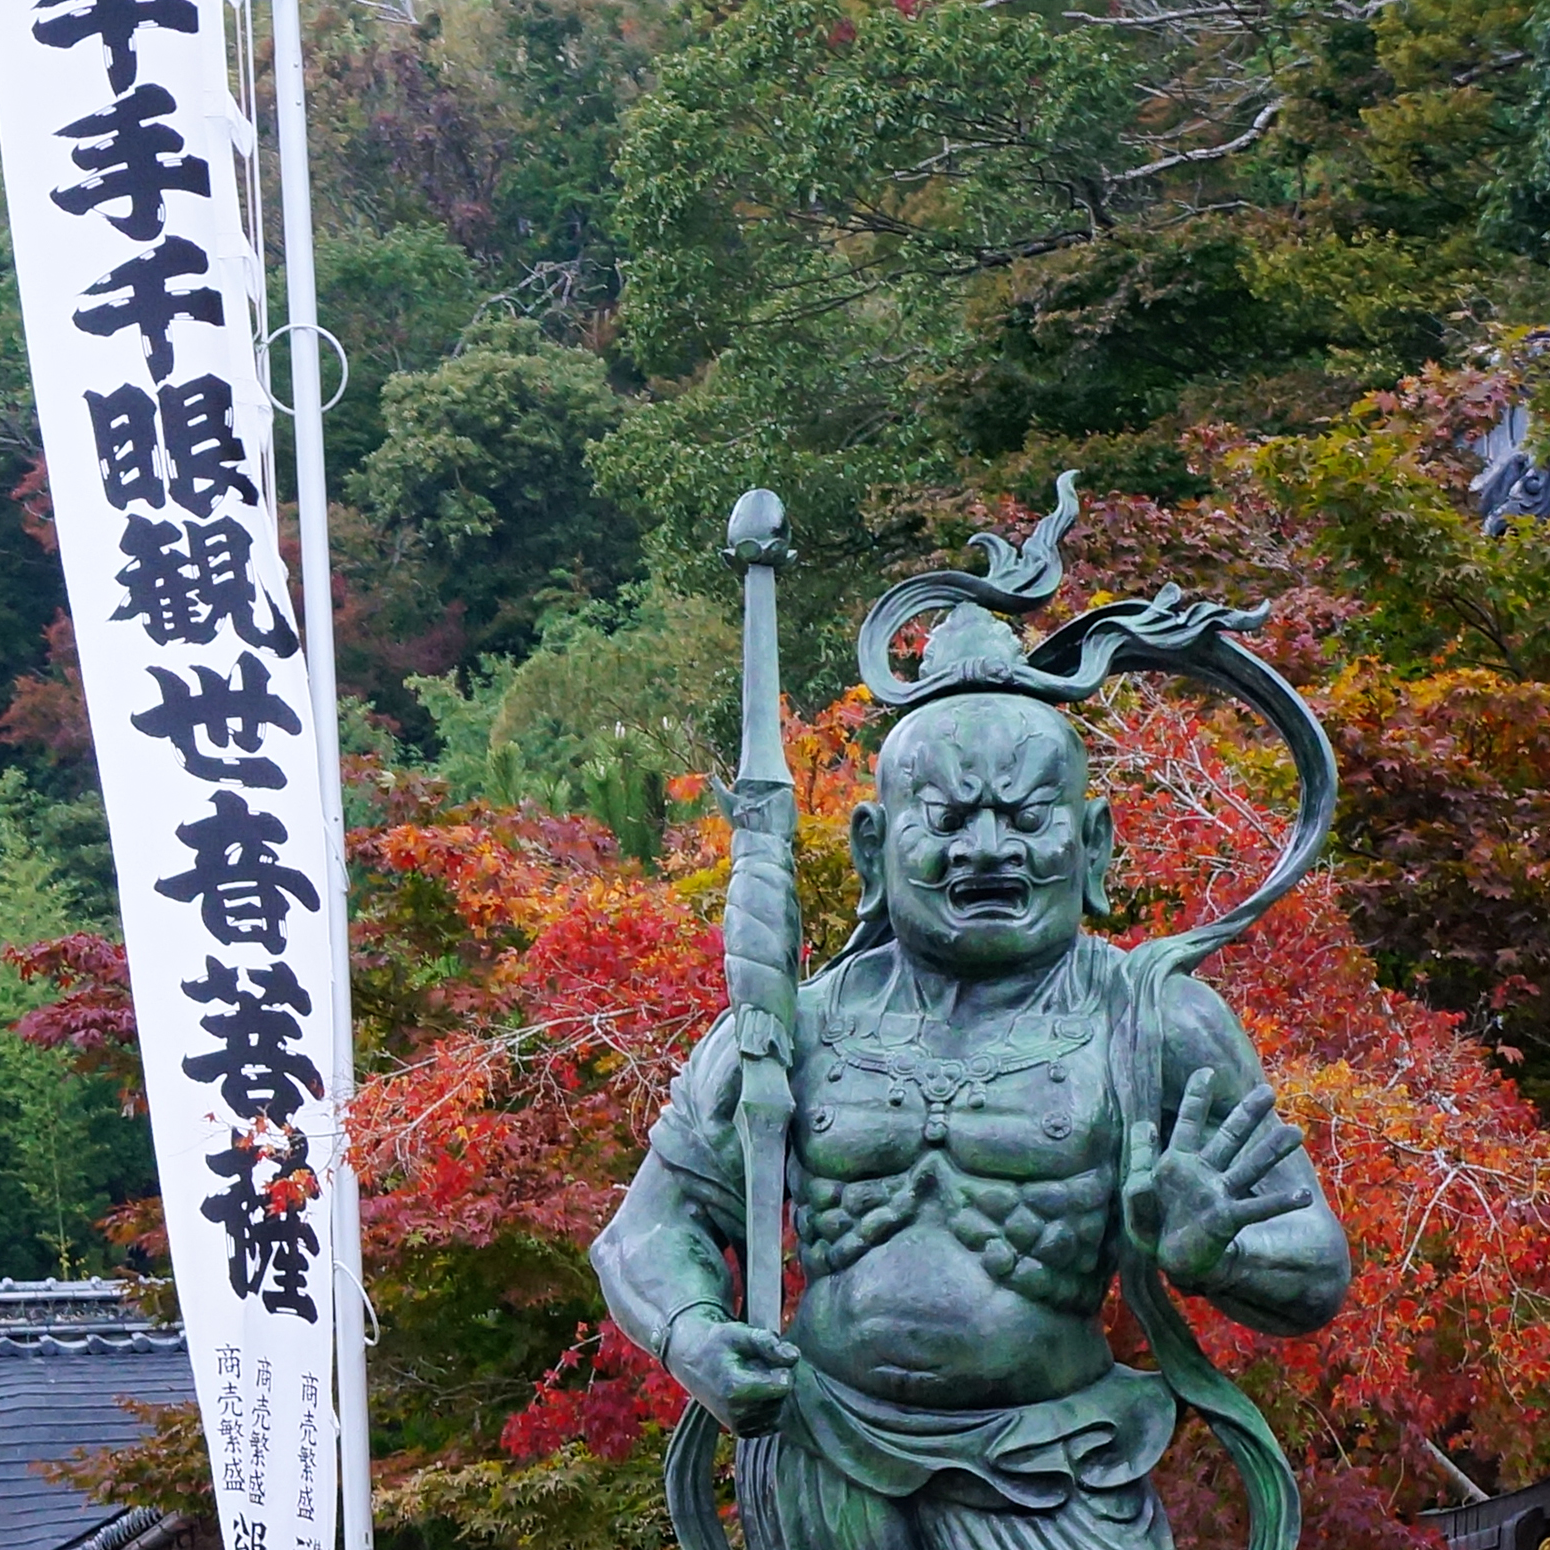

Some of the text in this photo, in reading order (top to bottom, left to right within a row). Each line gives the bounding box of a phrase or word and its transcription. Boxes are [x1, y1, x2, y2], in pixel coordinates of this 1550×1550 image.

[215, 1343, 245, 1492] 商売繁盛
[249, 1356, 272, 1506] 商売繁盛
[297, 1371, 319, 1521] 商売繁盛
